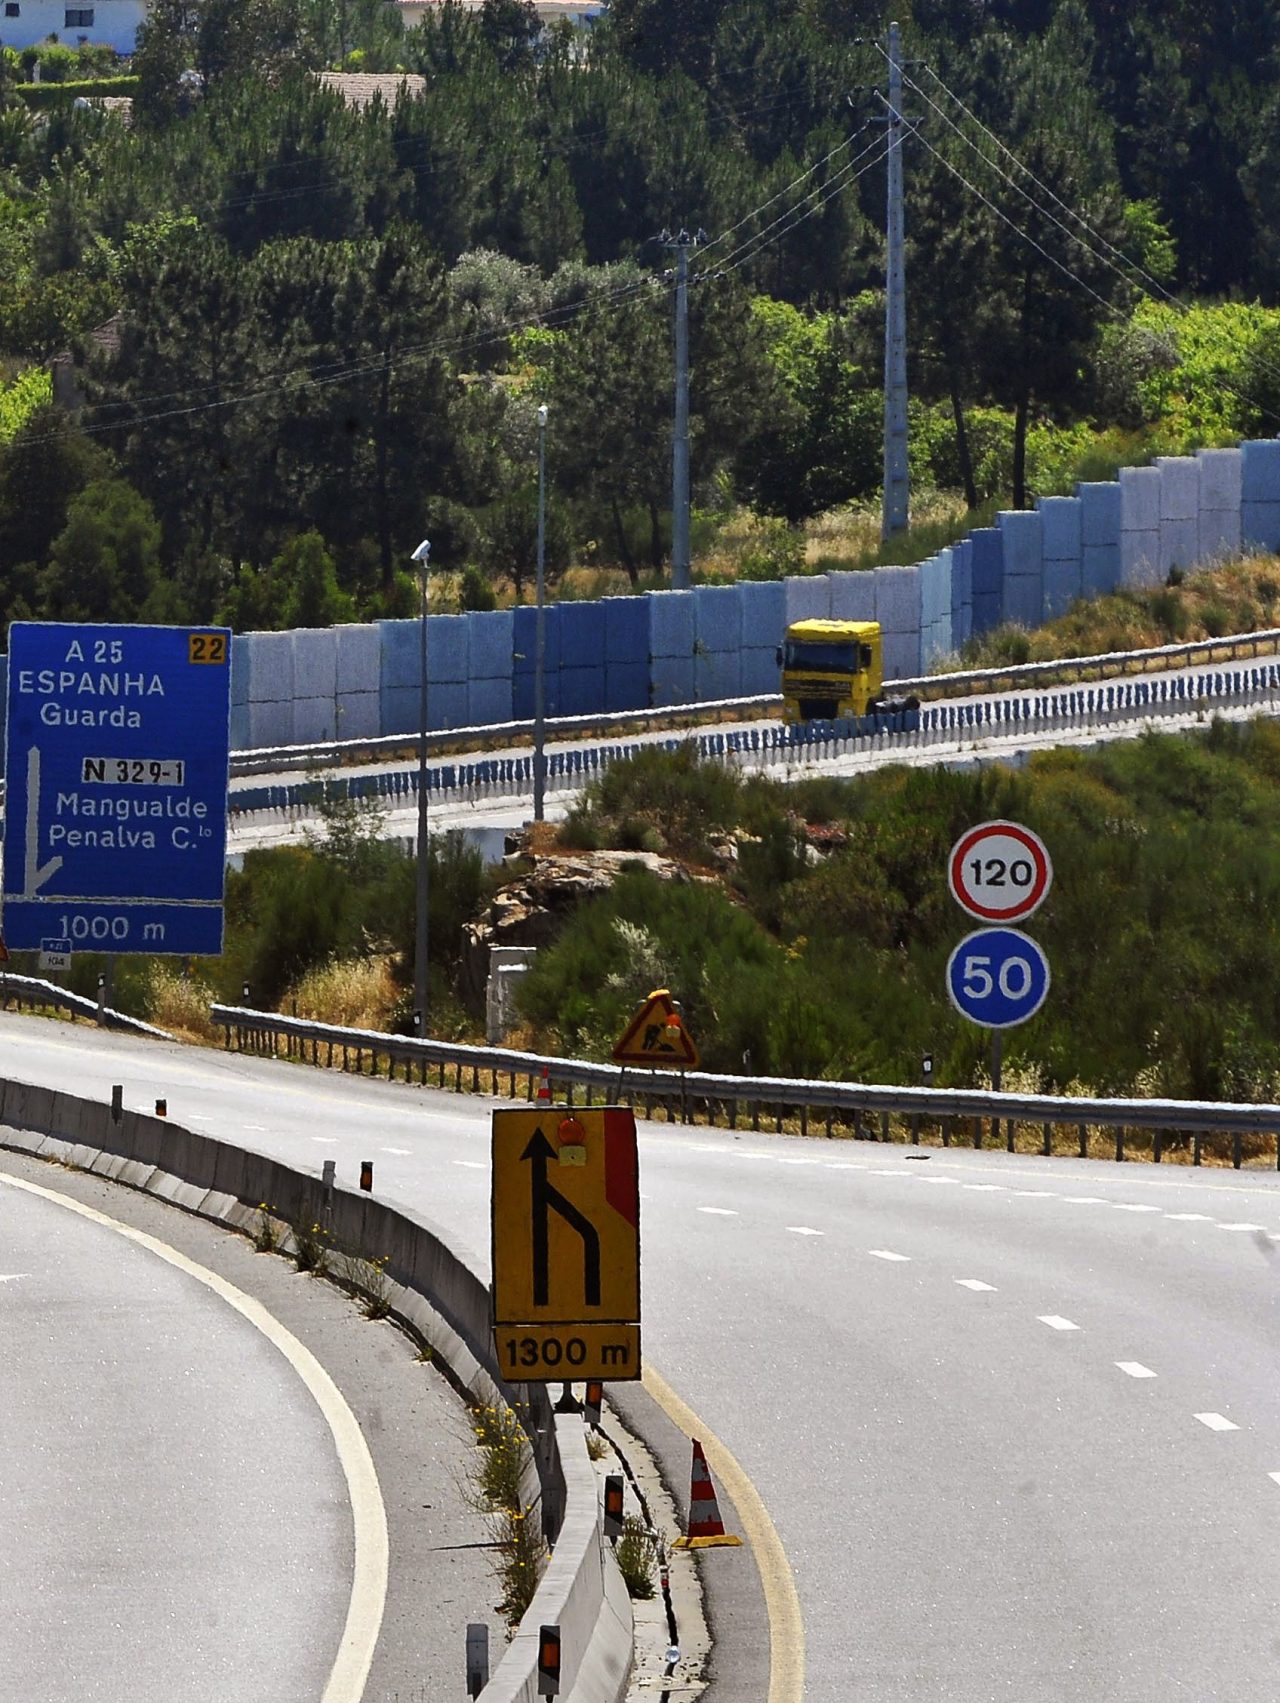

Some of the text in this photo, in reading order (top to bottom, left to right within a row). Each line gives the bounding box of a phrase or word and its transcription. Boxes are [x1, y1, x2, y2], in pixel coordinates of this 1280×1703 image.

[65, 640, 123, 664] A 25
[191, 637, 224, 661] 22
[19, 670, 165, 696] ESPANHA
[40, 702, 141, 728] Guarda
[82, 759, 184, 784] N 329-1
[56, 792, 208, 819] Mangualde
[49, 825, 156, 848] Penalva
[969, 858, 1033, 887] 120
[59, 916, 166, 940] 1000 m
[962, 955, 1033, 1001] 50
[506, 1337, 629, 1368] 1300 m
